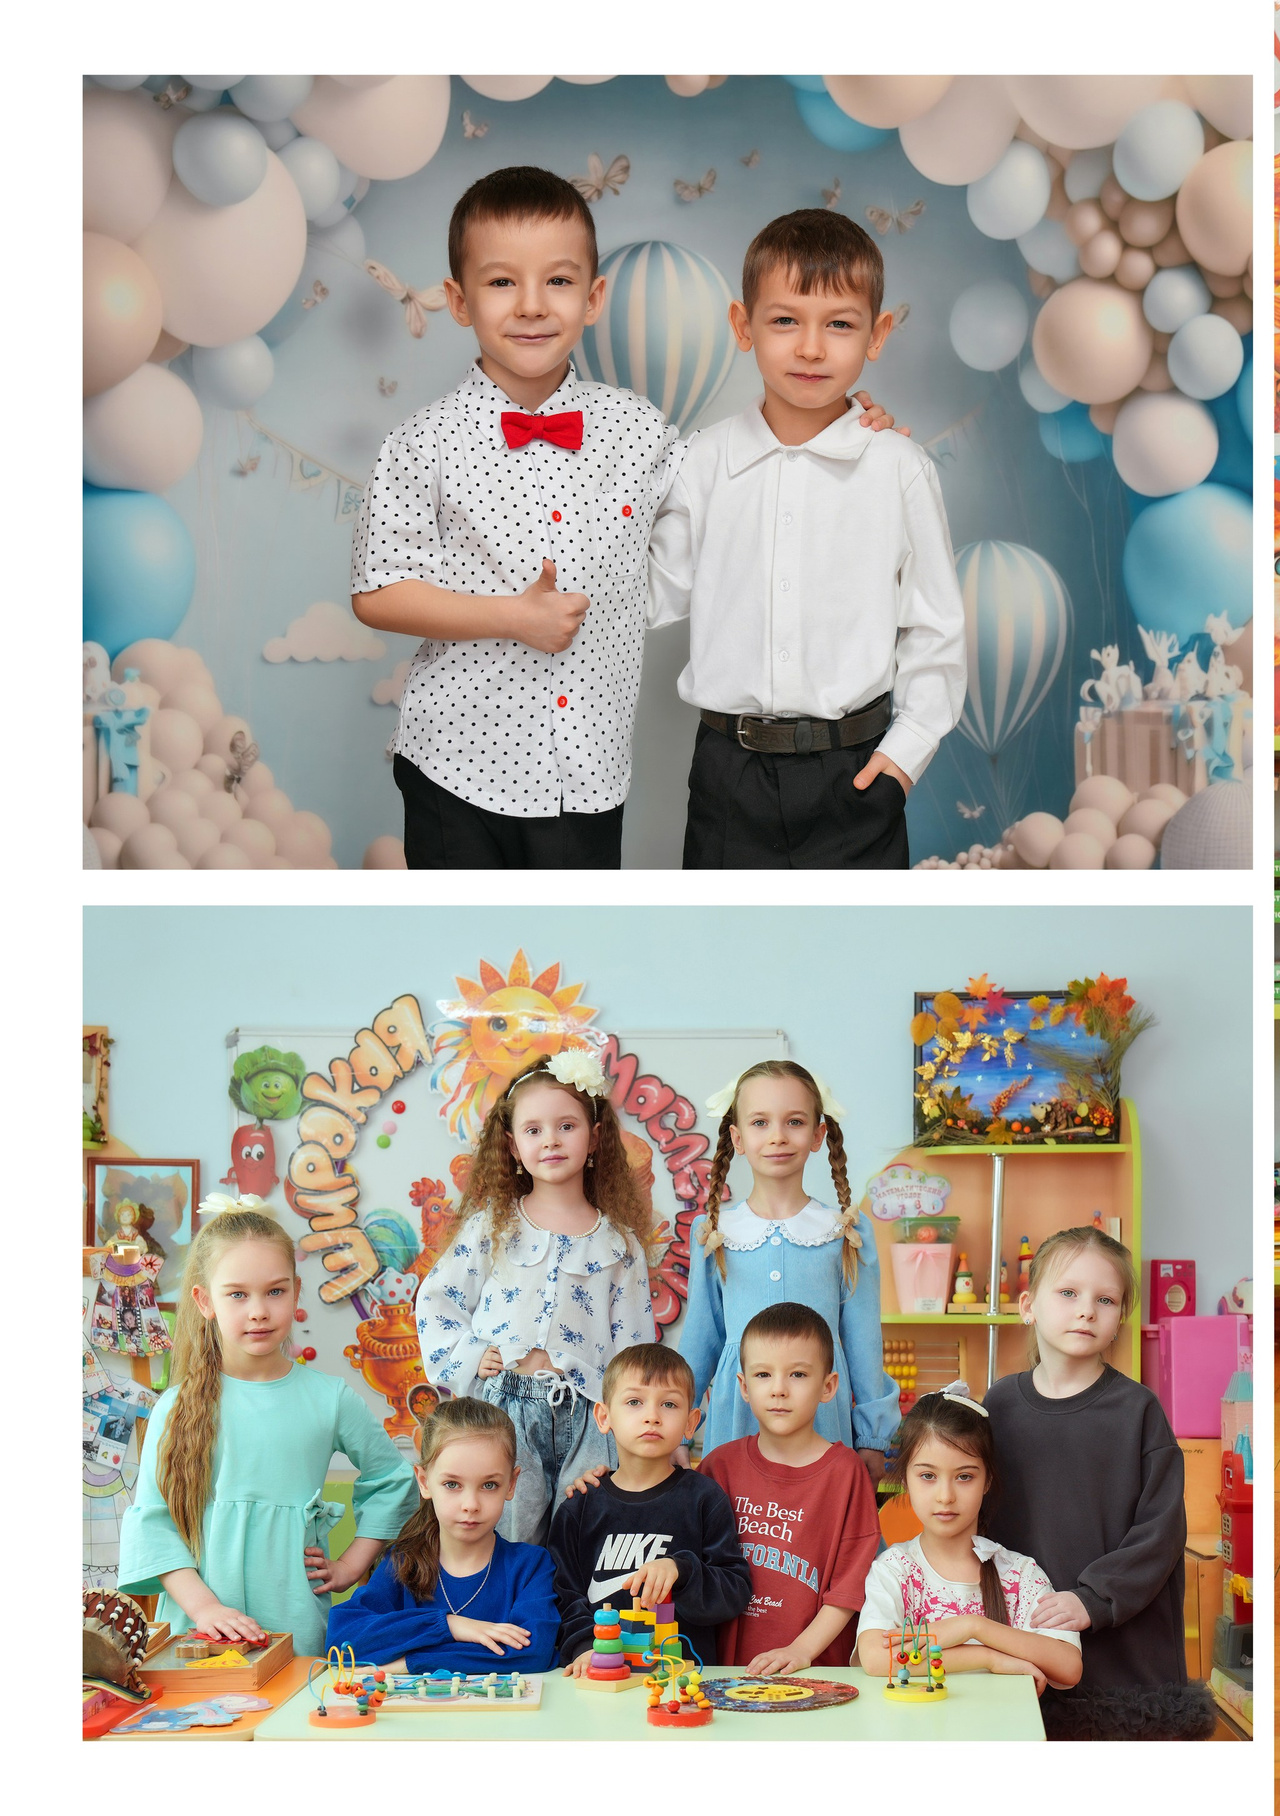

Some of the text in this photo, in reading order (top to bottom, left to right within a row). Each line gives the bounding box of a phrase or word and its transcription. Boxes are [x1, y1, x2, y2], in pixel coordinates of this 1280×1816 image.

[735, 1496, 804, 1522] The Best
[738, 1515, 793, 1543] Beach
[595, 1533, 674, 1571] NIKE
[764, 1597, 783, 1607] Beach
